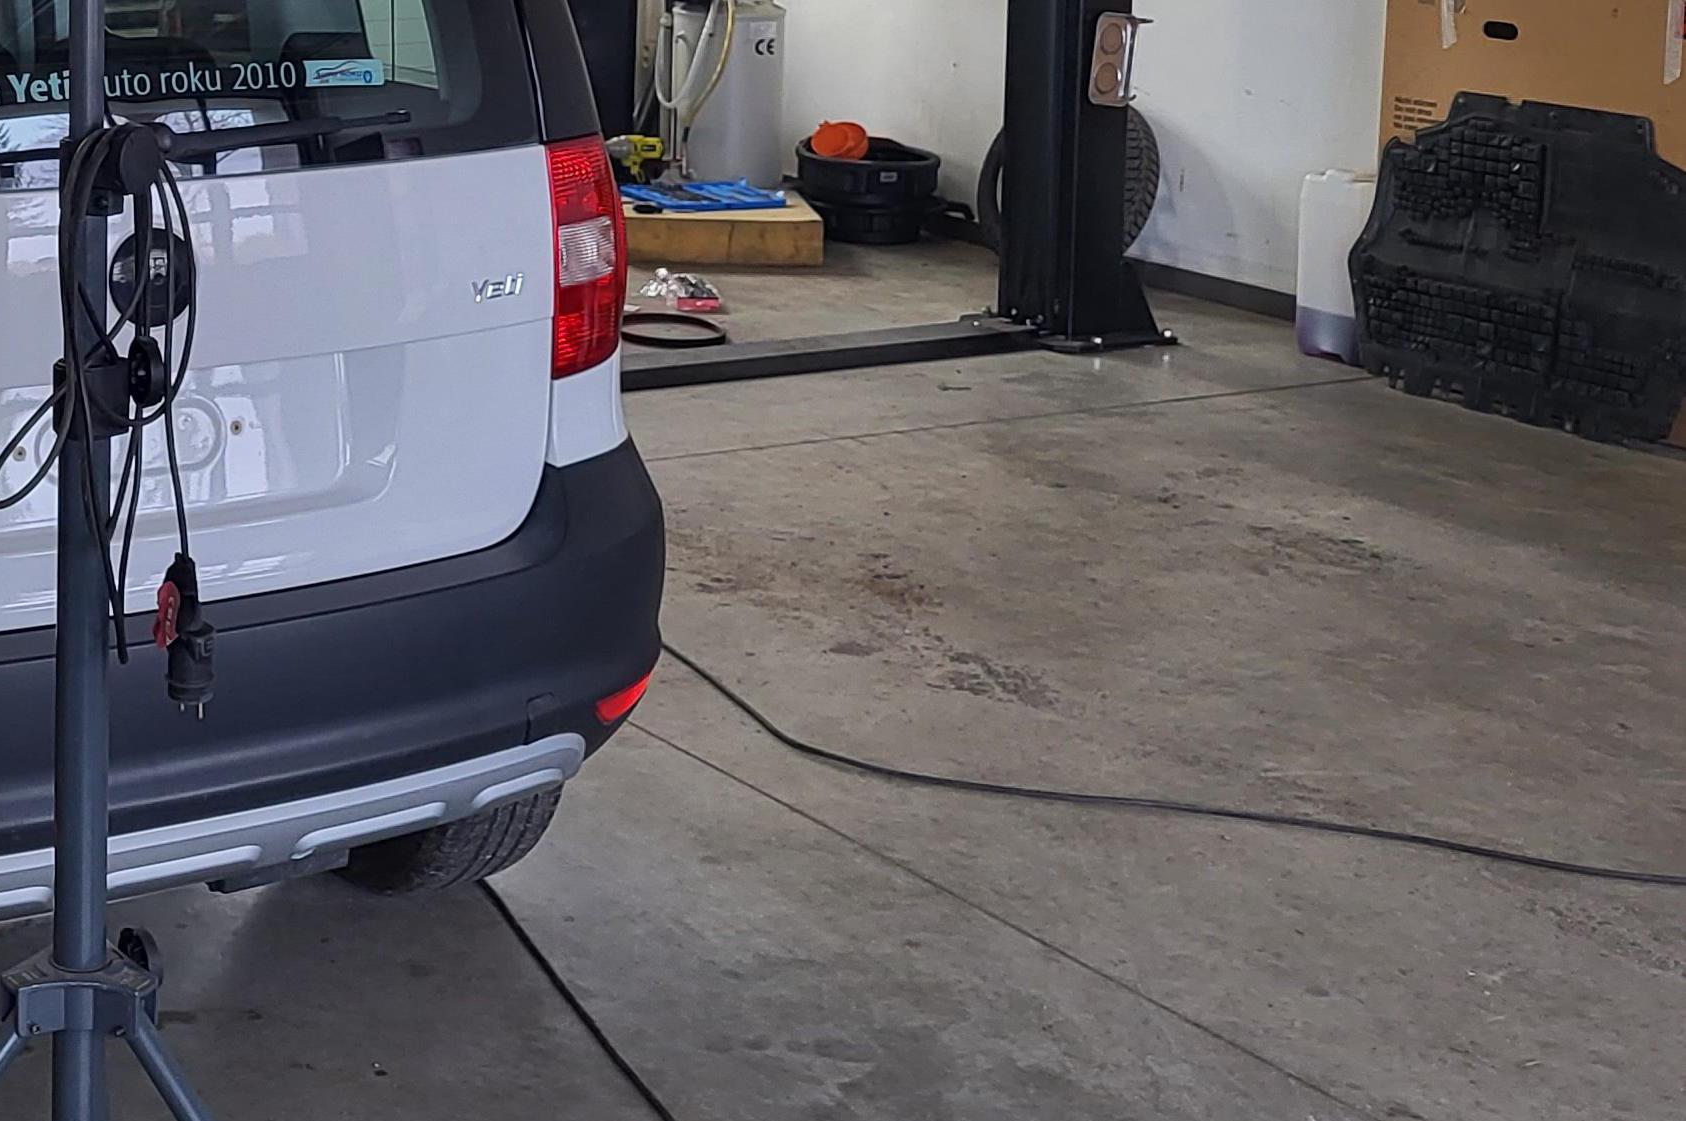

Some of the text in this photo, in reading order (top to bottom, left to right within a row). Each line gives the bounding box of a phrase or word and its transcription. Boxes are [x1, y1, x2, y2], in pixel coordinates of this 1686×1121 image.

[6, 69, 70, 103] Yeti
[103, 67, 151, 98] uto
[159, 61, 222, 94] roku
[229, 60, 297, 91] 2010
